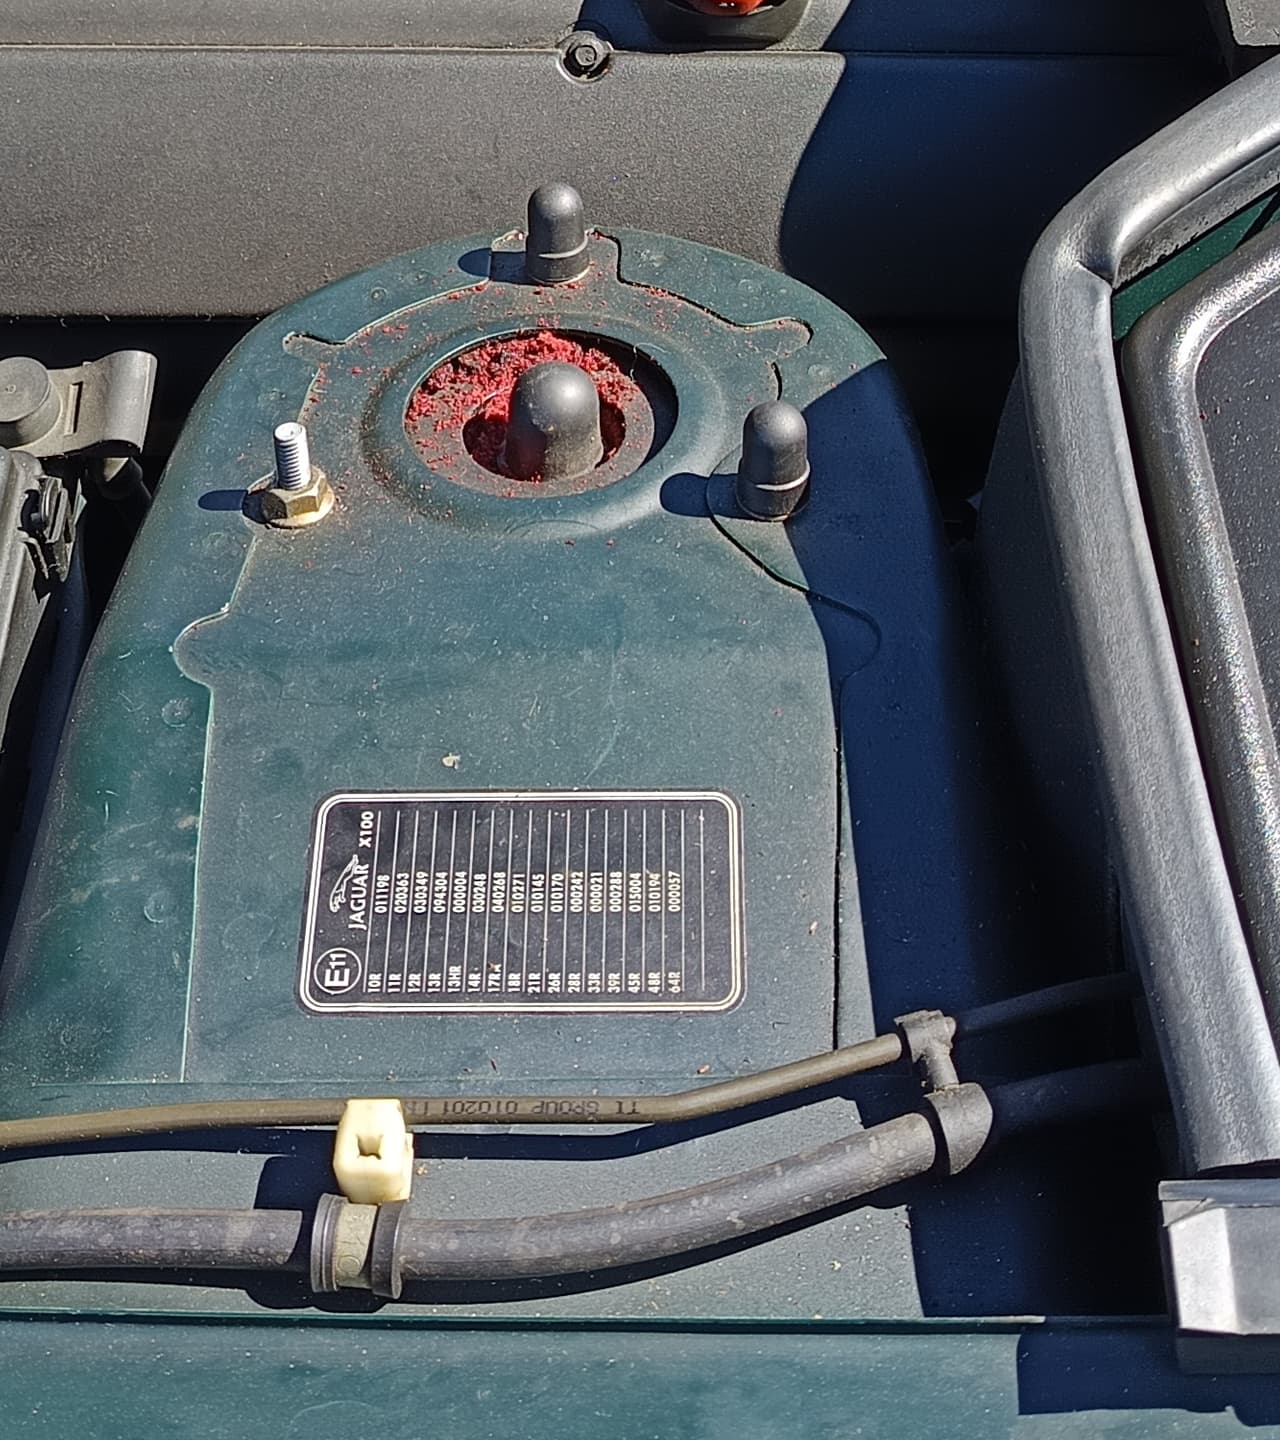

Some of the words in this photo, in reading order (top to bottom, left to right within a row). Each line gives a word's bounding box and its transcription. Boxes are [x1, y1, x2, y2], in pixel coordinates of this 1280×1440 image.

[346, 862, 369, 931] JAGUAR
[358, 811, 375, 848] X100
[374, 874, 390, 914] 011198
[394, 872, 409, 914] 020363
[413, 872, 429, 914] 030349
[433, 872, 448, 914] 094304
[452, 872, 467, 914] 000004
[472, 874, 487, 914] 030248
[492, 872, 506, 913] 040268
[511, 874, 525, 913] 010271
[531, 874, 545, 913] 010145
[551, 874, 564, 913] 010170
[570, 871, 583, 913] 000242
[590, 871, 603, 913] 000021
[610, 871, 622, 913] 000288
[629, 871, 641, 913] 015004
[649, 871, 661, 913] 010194
[668, 871, 680, 913] 000057
[368, 973, 383, 993] 10R
[388, 973, 403, 993] 11R
[408, 973, 423, 993] 12R
[428, 973, 442, 993] 13R
[448, 965, 463, 993] 13HR
[468, 973, 482, 993] 14R
[508, 973, 522, 993] 18R
[527, 973, 542, 993] 21R
[547, 972, 562, 993] 26R
[567, 972, 582, 993] 28R
[587, 972, 602, 993] 33R
[607, 972, 622, 993] 39R
[627, 972, 642, 993] 45R
[647, 972, 662, 993] 48R
[667, 972, 682, 993] 64R
[442, 1100, 519, 1116] 010201
[531, 1100, 600, 1116] GROUP
[614, 1100, 641, 1116] TI
